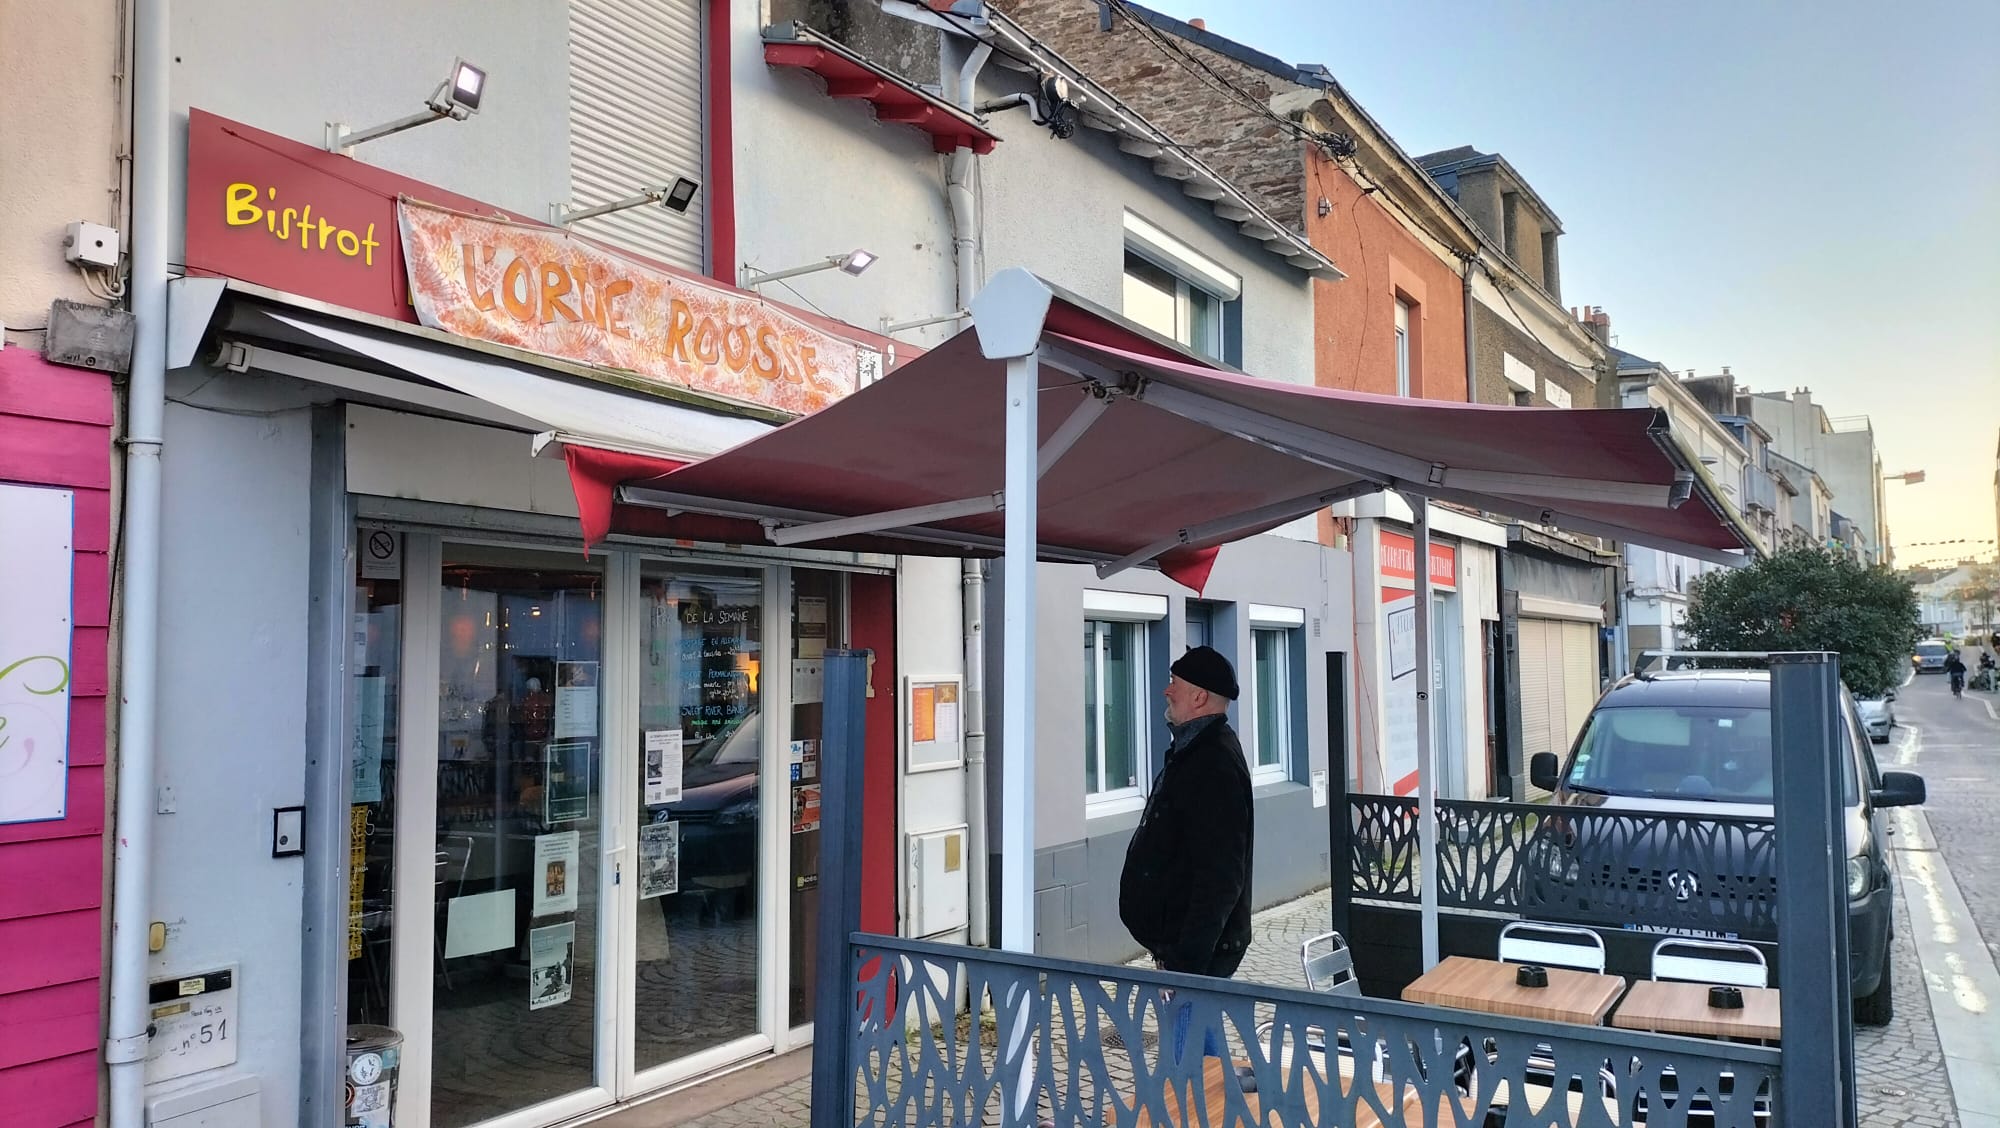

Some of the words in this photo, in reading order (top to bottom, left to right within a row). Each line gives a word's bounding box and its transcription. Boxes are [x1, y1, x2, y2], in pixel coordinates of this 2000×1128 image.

[226, 183, 380, 266] Bistrot
[662, 299, 832, 394] ROUSSE
[703, 611, 714, 624] LA
